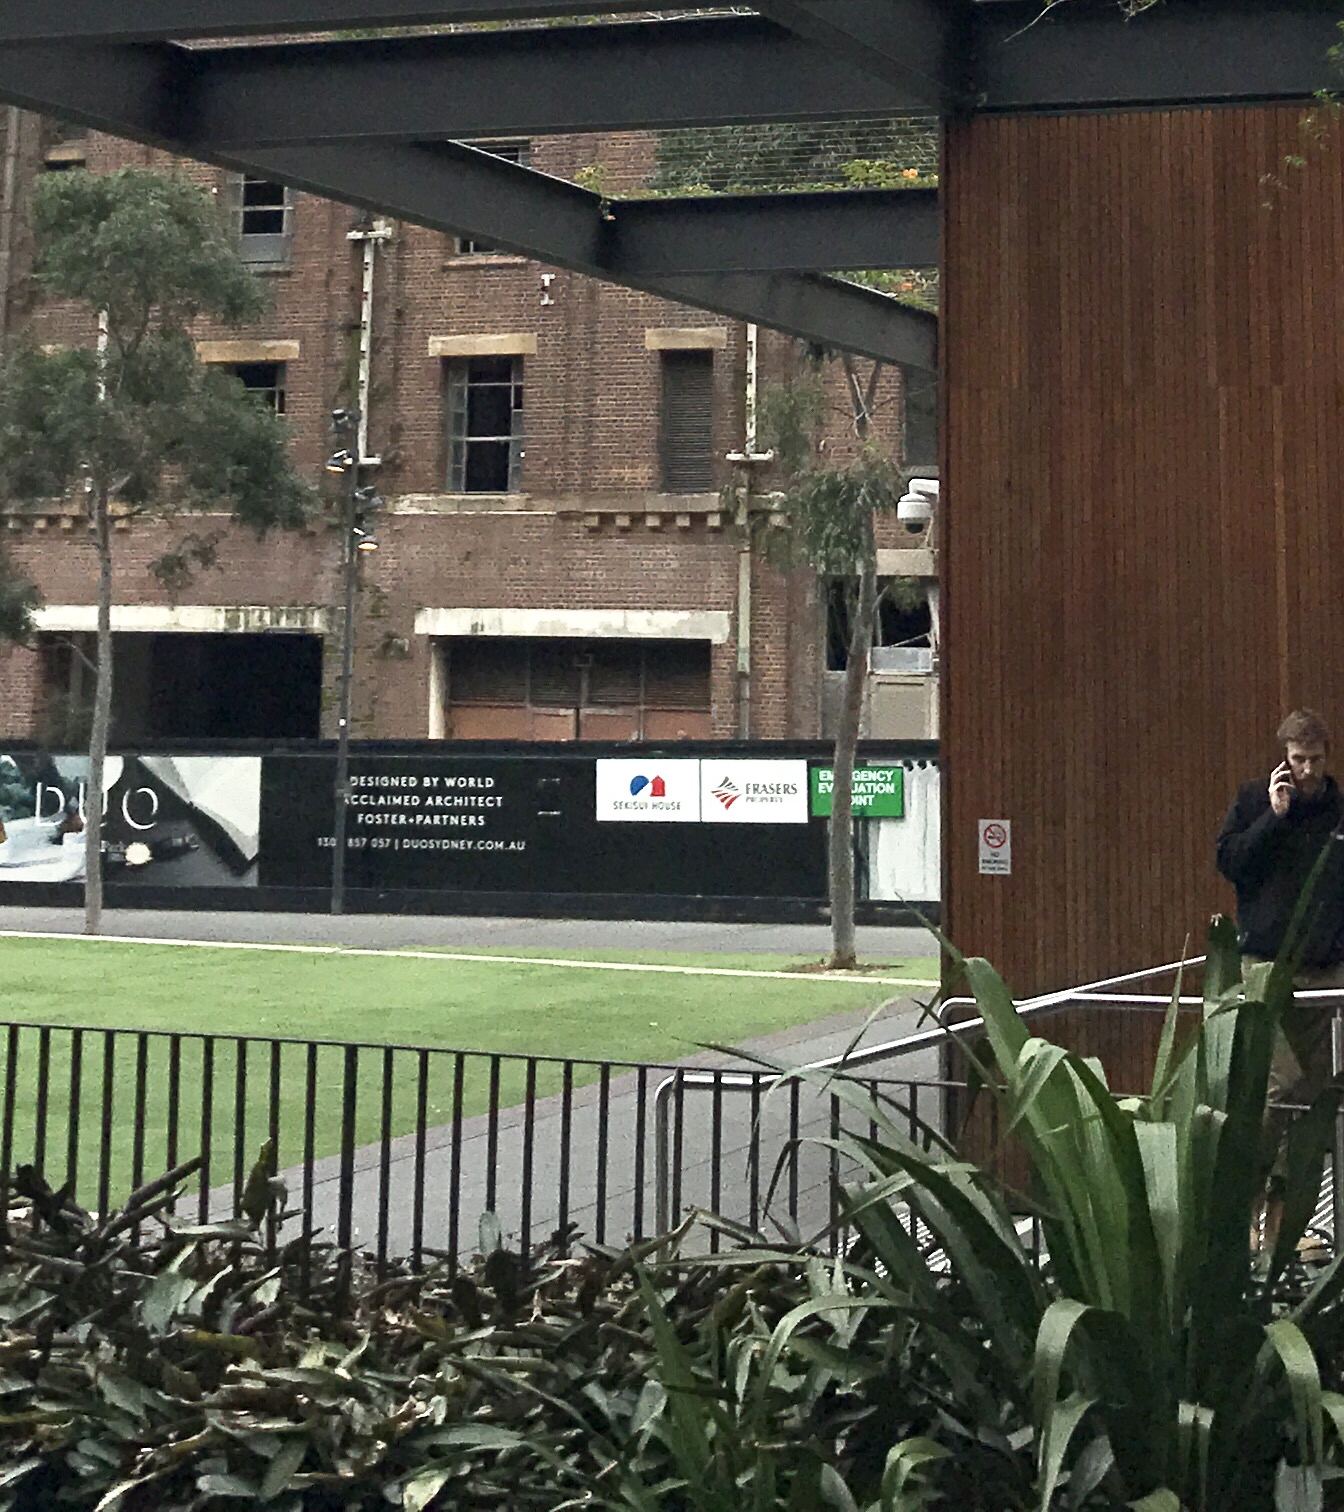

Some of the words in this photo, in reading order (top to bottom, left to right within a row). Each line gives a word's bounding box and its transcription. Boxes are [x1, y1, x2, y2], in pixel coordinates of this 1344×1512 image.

[819, 770, 894, 781] EMGENCY
[350, 776, 418, 787] DESIGNED
[423, 777, 440, 787] BY
[444, 777, 495, 788] WORLD
[745, 783, 798, 795] FRASERS
[35, 782, 159, 830] DUO
[344, 795, 420, 806] ACCLAIMED
[425, 796, 503, 807] ARCHITECT
[652, 802, 681, 810] HOUSE
[357, 813, 486, 826] FOSTER+PARTNERS
[403, 838, 526, 851] DUOSYDNEY.COM.AU
